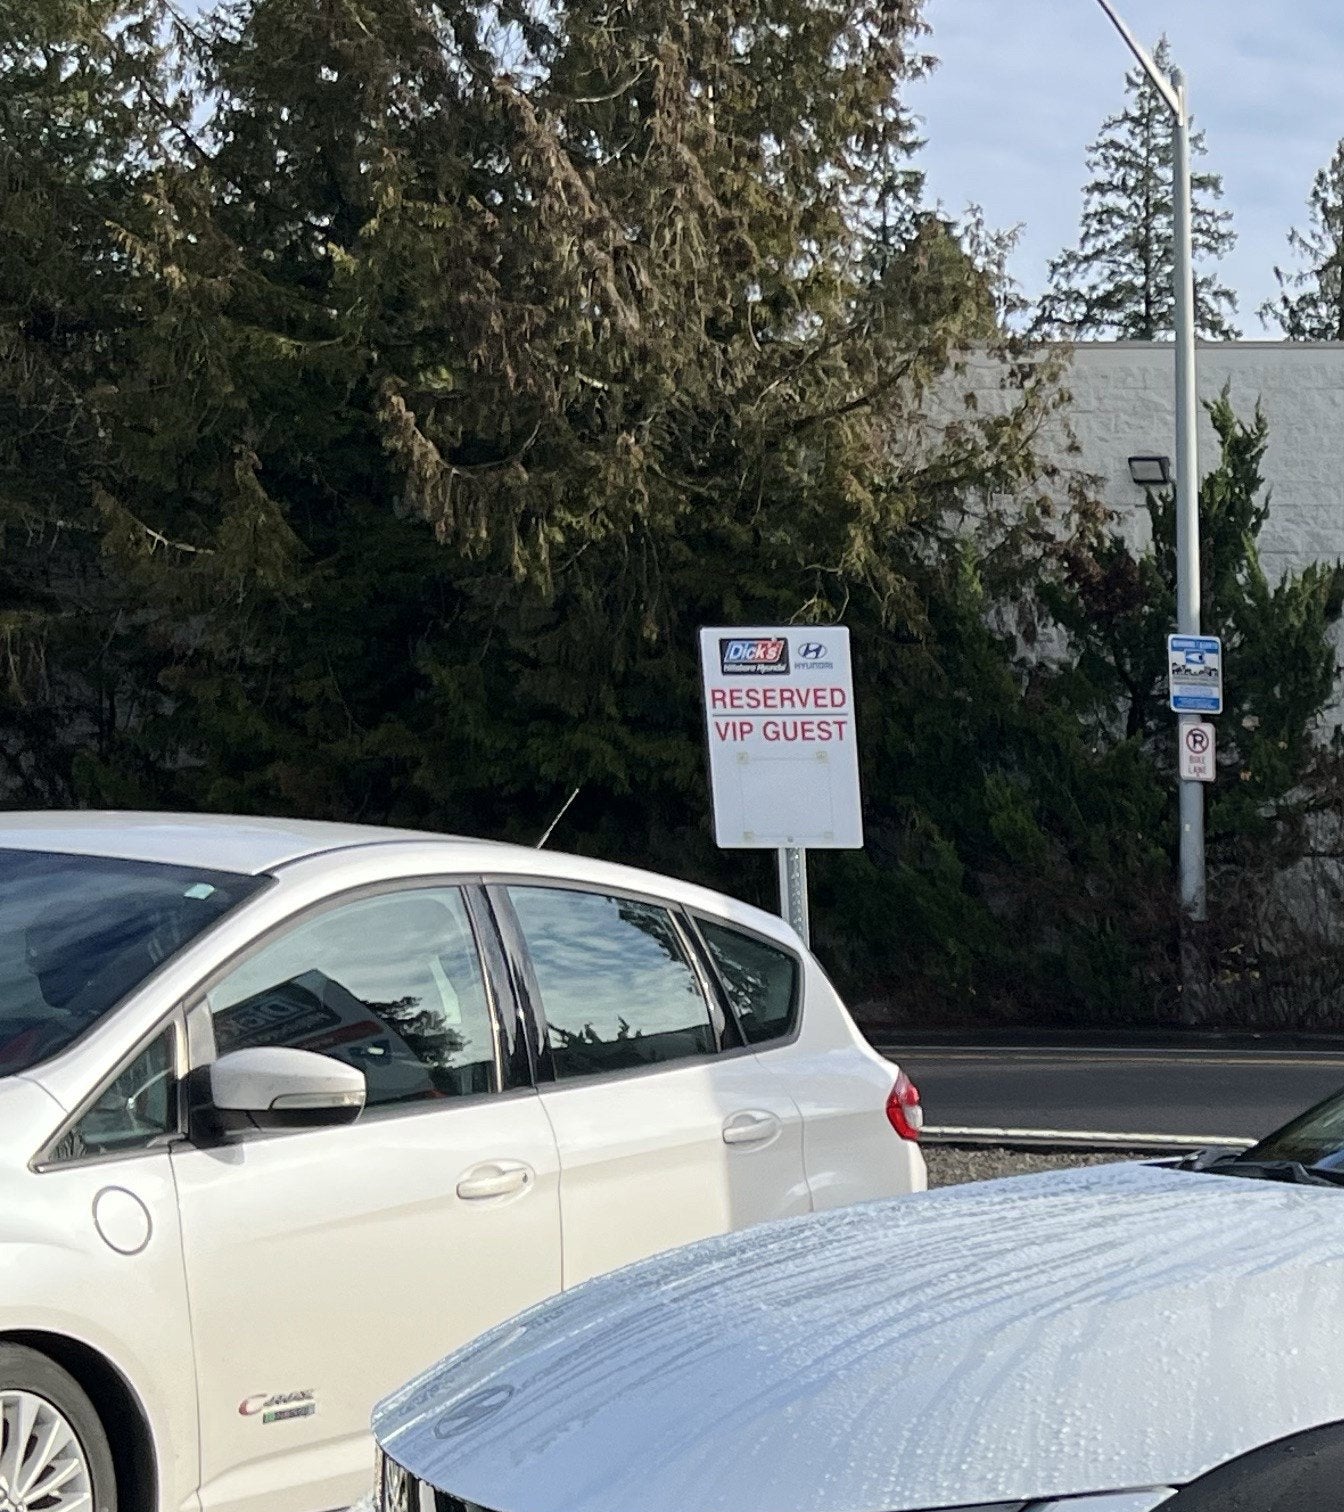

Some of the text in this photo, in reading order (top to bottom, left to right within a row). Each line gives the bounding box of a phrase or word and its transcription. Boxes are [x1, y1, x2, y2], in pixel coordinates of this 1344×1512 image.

[711, 688, 847, 709] RESERVED
[715, 720, 848, 741] VIP GUEST
